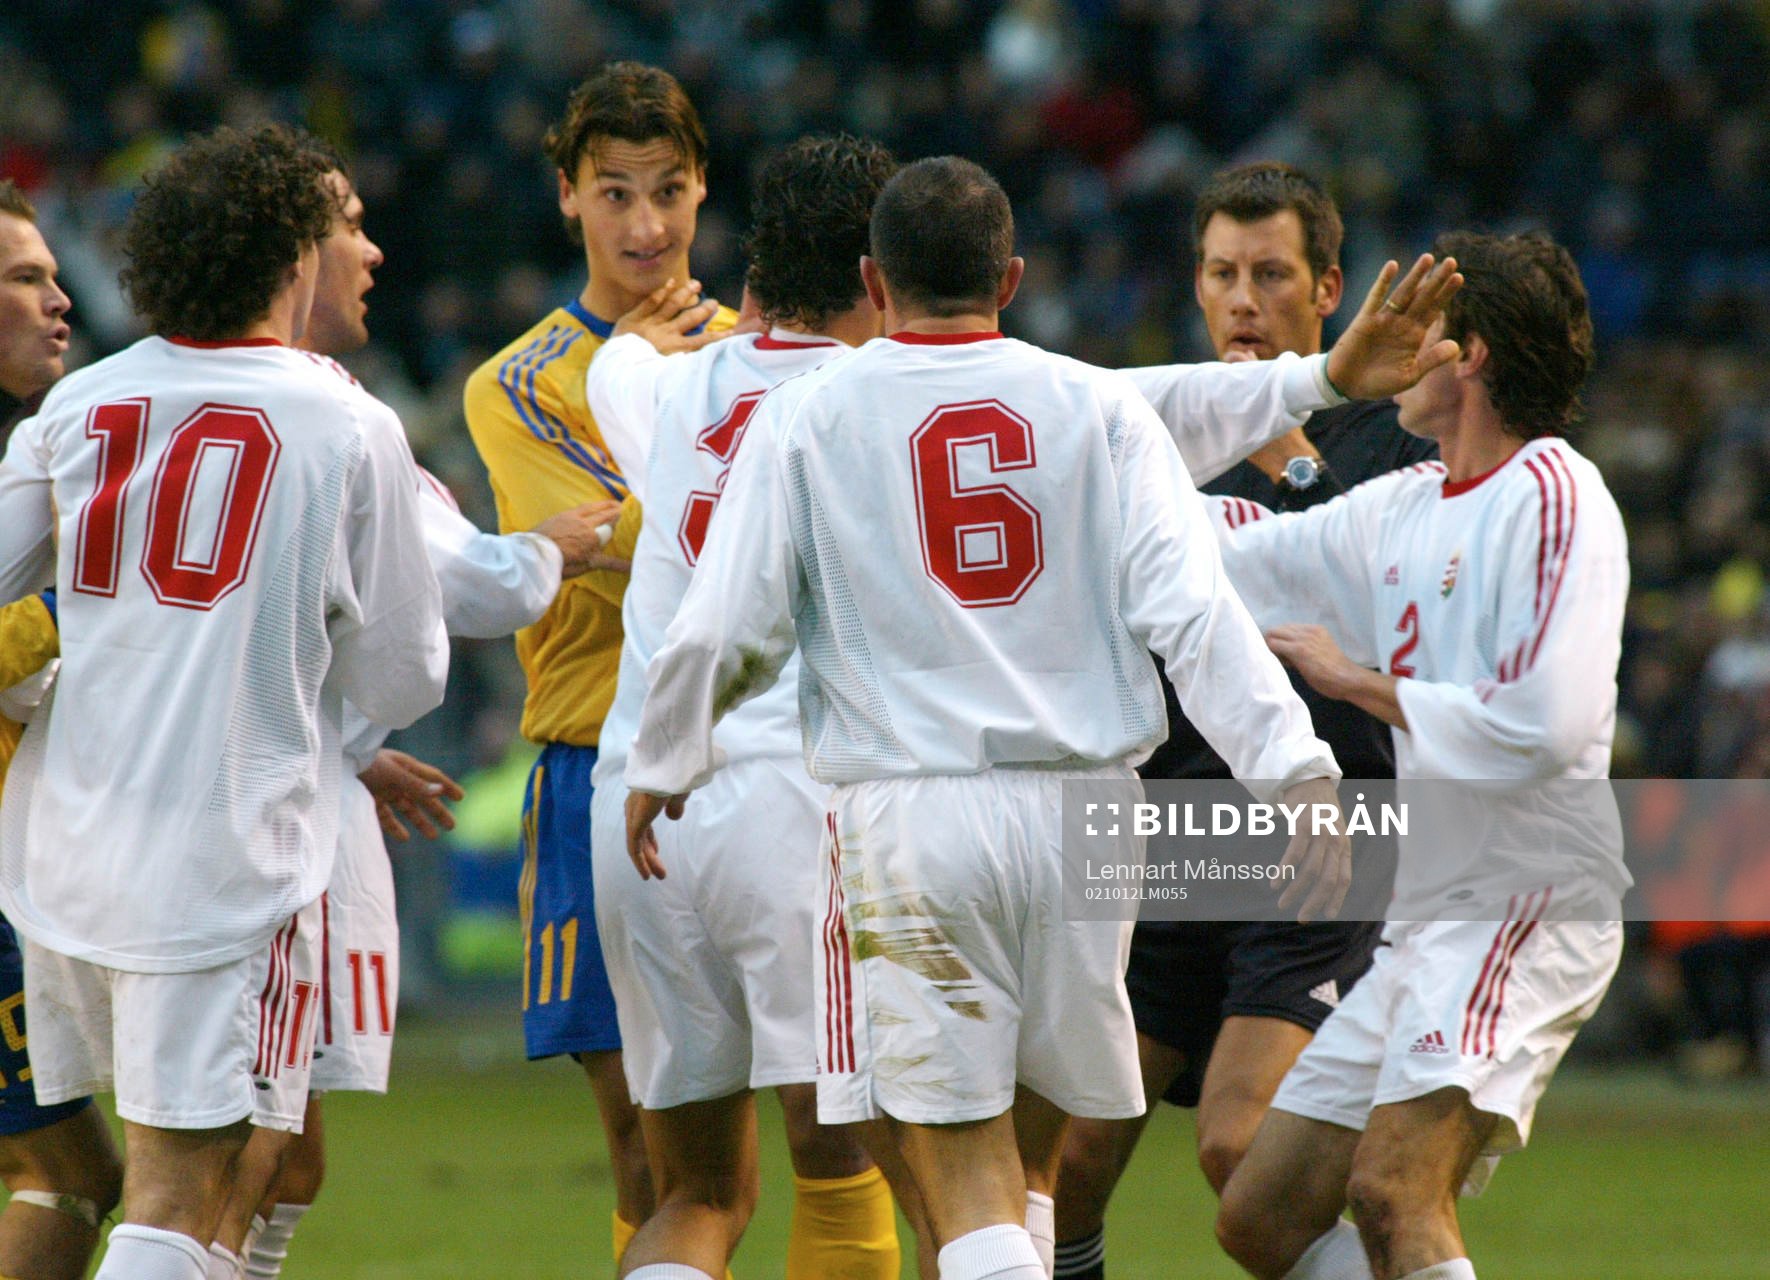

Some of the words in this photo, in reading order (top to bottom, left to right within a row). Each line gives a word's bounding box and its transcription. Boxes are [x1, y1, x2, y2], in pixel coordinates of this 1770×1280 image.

[73, 397, 282, 611] 10
[909, 398, 1045, 609] 6
[1389, 600, 1420, 679] 2
[347, 949, 393, 1035] 11
[538, 917, 578, 1004] 11
